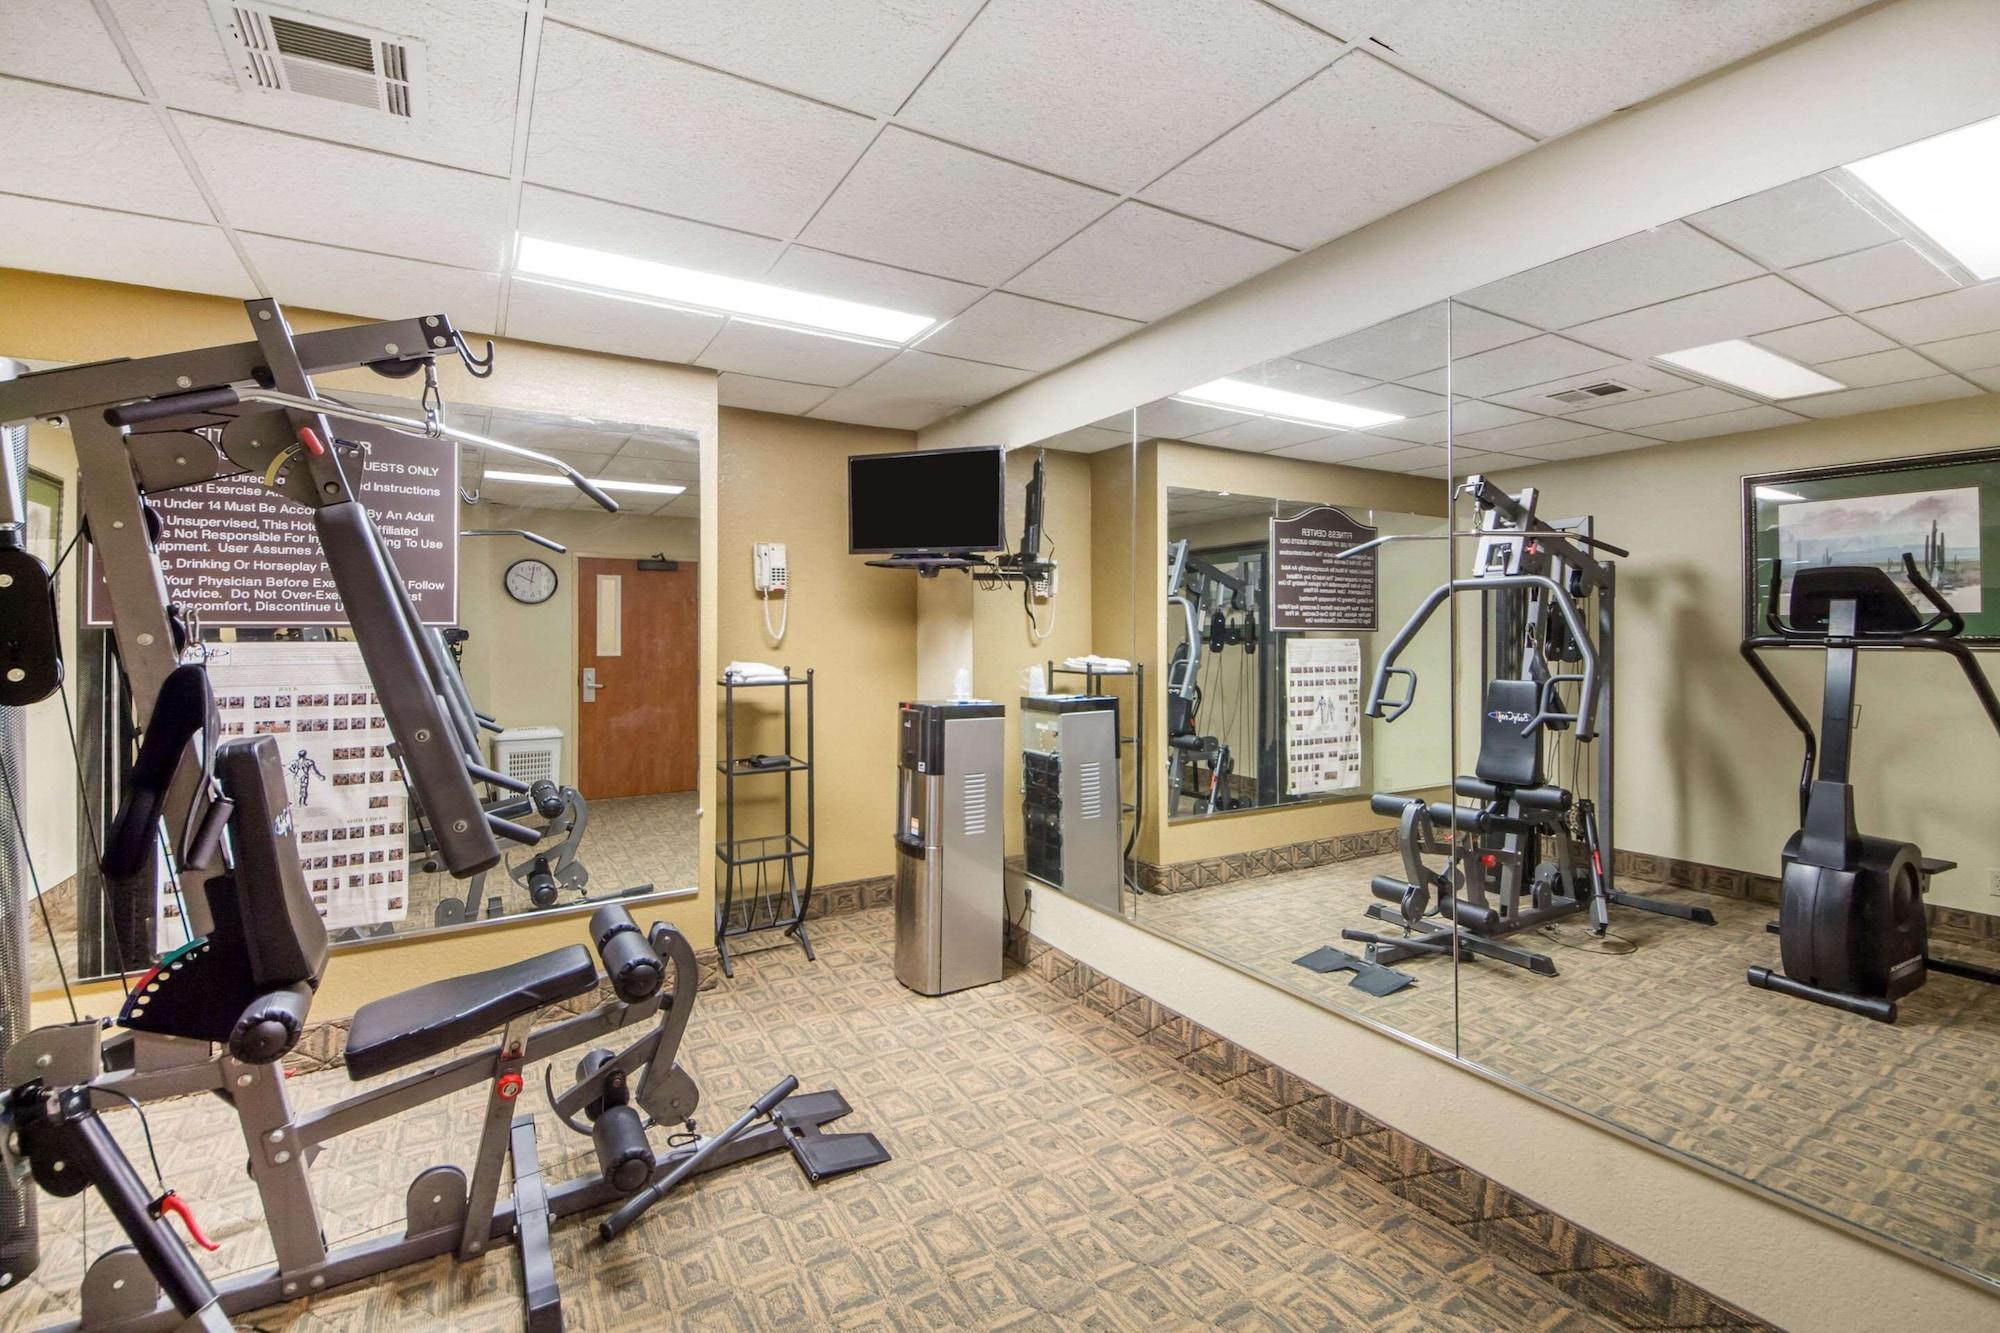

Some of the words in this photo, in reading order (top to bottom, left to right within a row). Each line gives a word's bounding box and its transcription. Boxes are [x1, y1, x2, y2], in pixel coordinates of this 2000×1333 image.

[363, 461, 404, 473] UESTS
[408, 465, 439, 476] ONLY
[206, 483, 262, 496] Exercise
[374, 482, 440, 496] Instructions
[164, 498, 204, 510] Under
[208, 500, 221, 510] 14
[224, 501, 255, 512] Must
[258, 503, 276, 513] Be
[367, 509, 382, 520] By
[386, 510, 402, 520] An
[405, 512, 435, 522] Adult
[167, 515, 259, 530] Unsupervised,
[262, 519, 288, 530] This
[174, 529, 198, 539] Not
[202, 530, 280, 543] Responsible
[284, 533, 304, 544] For
[405, 538, 418, 548] To
[421, 539, 444, 549] Use
[157, 541, 211, 553] uipment.
[218, 543, 248, 554] User
[253, 545, 311, 556] Assumes
[176, 558, 231, 572] Drinking
[234, 559, 249, 570] Or
[253, 560, 317, 574] Horseplay
[164, 575, 194, 586] Your
[198, 576, 262, 590] Physician
[266, 576, 309, 588] Before
[408, 580, 445, 590] Follow
[171, 588, 223, 599] Advice.
[231, 589, 250, 599] Do
[254, 589, 277, 599] Not
[172, 600, 251, 613] Discomfort,
[256, 601, 331, 612] Discontinue
